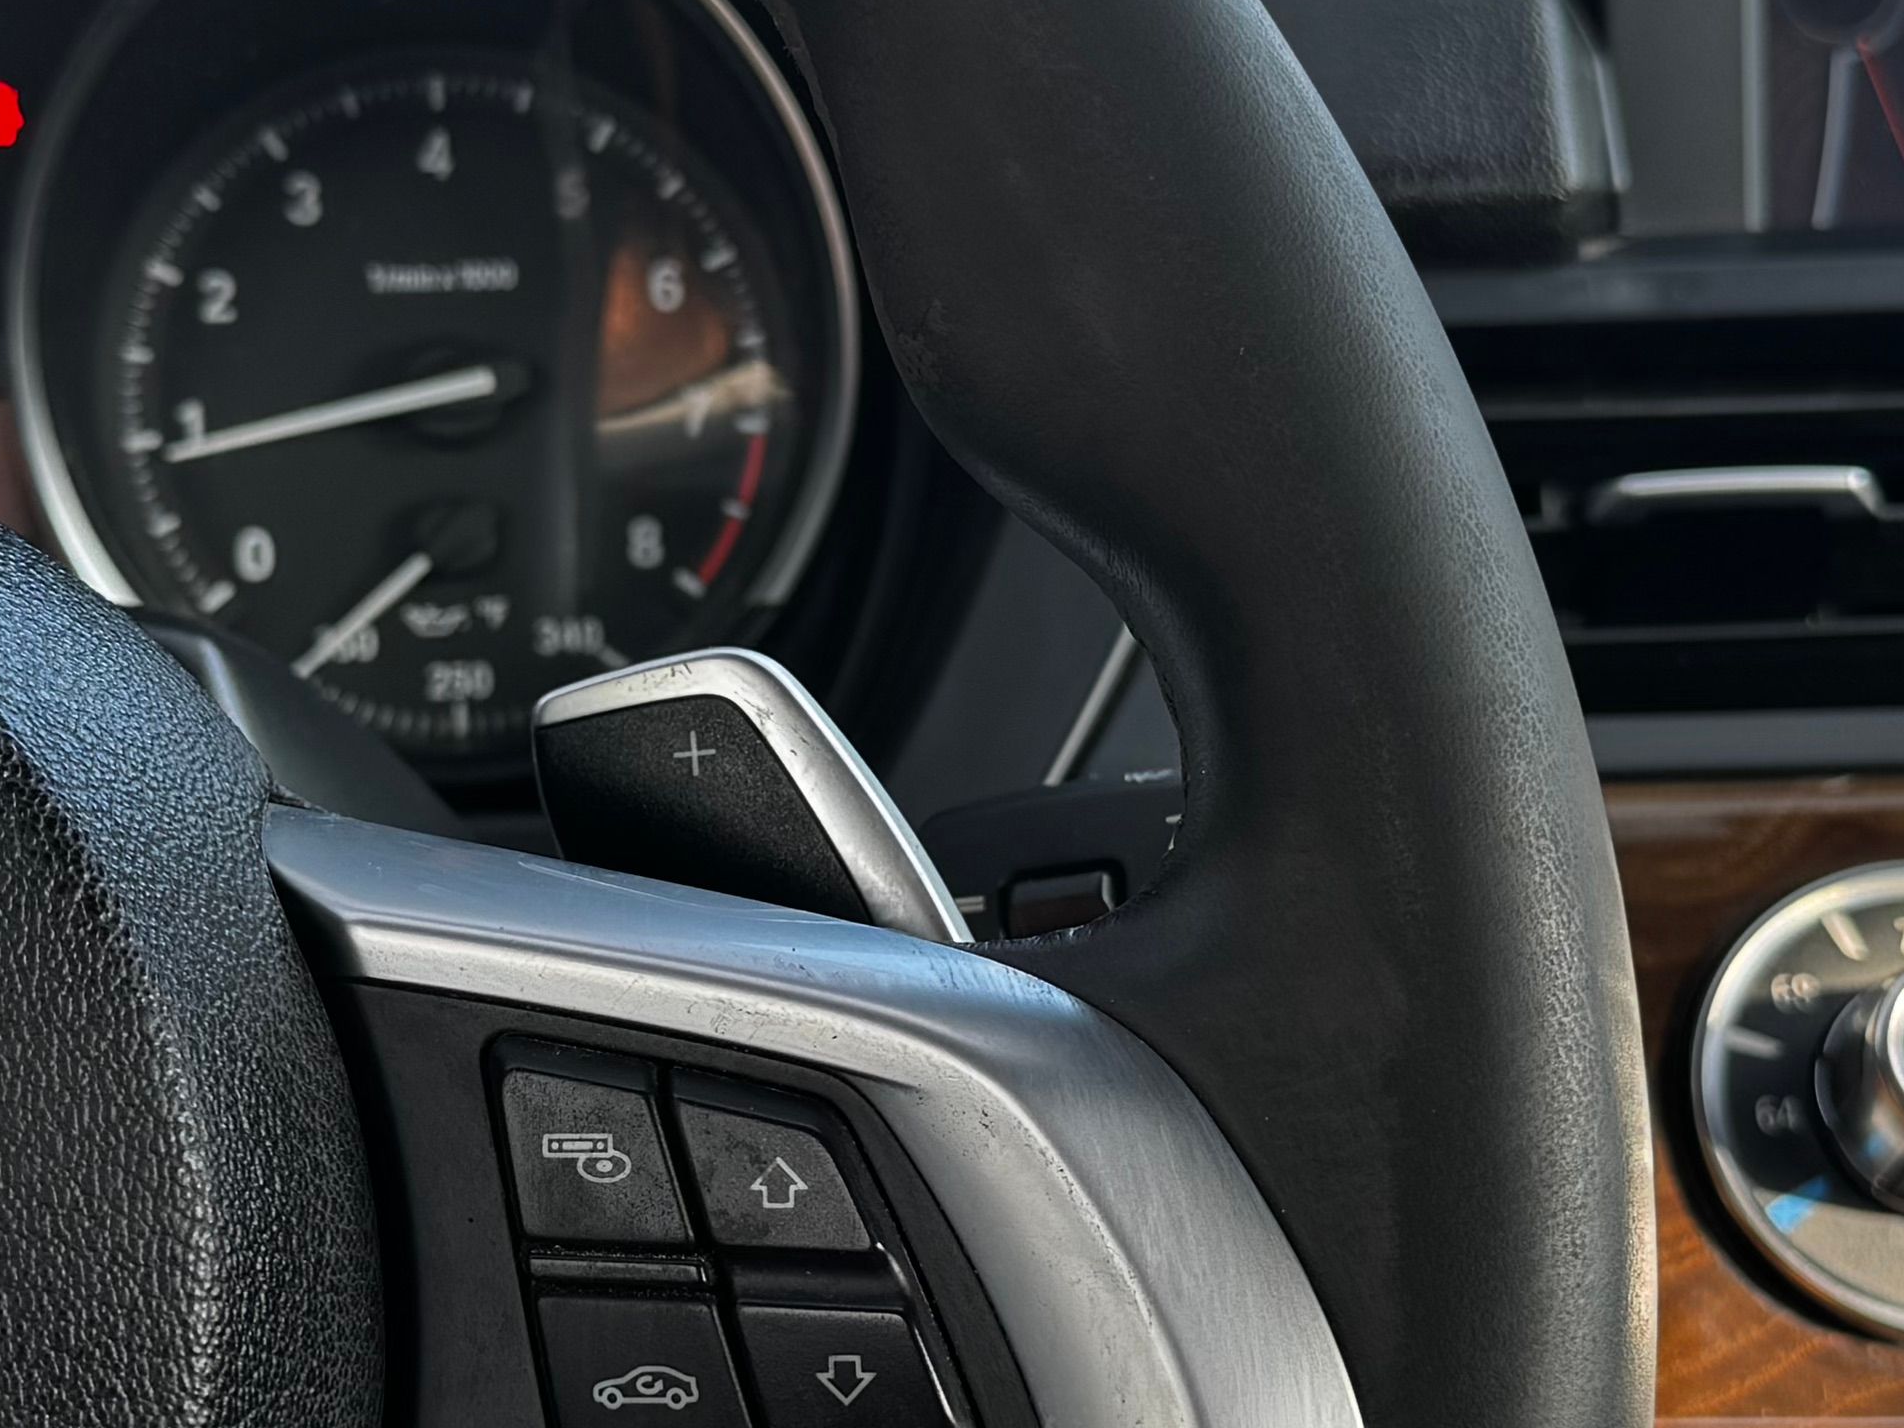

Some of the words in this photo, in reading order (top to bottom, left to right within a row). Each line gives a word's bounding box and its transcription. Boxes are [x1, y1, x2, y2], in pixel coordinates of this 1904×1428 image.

[417, 126, 454, 180] 4
[283, 169, 323, 226] 3
[199, 268, 238, 324] 2
[647, 258, 685, 313] 6
[175, 397, 205, 448] 1
[234, 525, 275, 582] 0
[627, 513, 664, 569] 8
[425, 660, 494, 702] 250
[1755, 1094, 1802, 1135] 64
